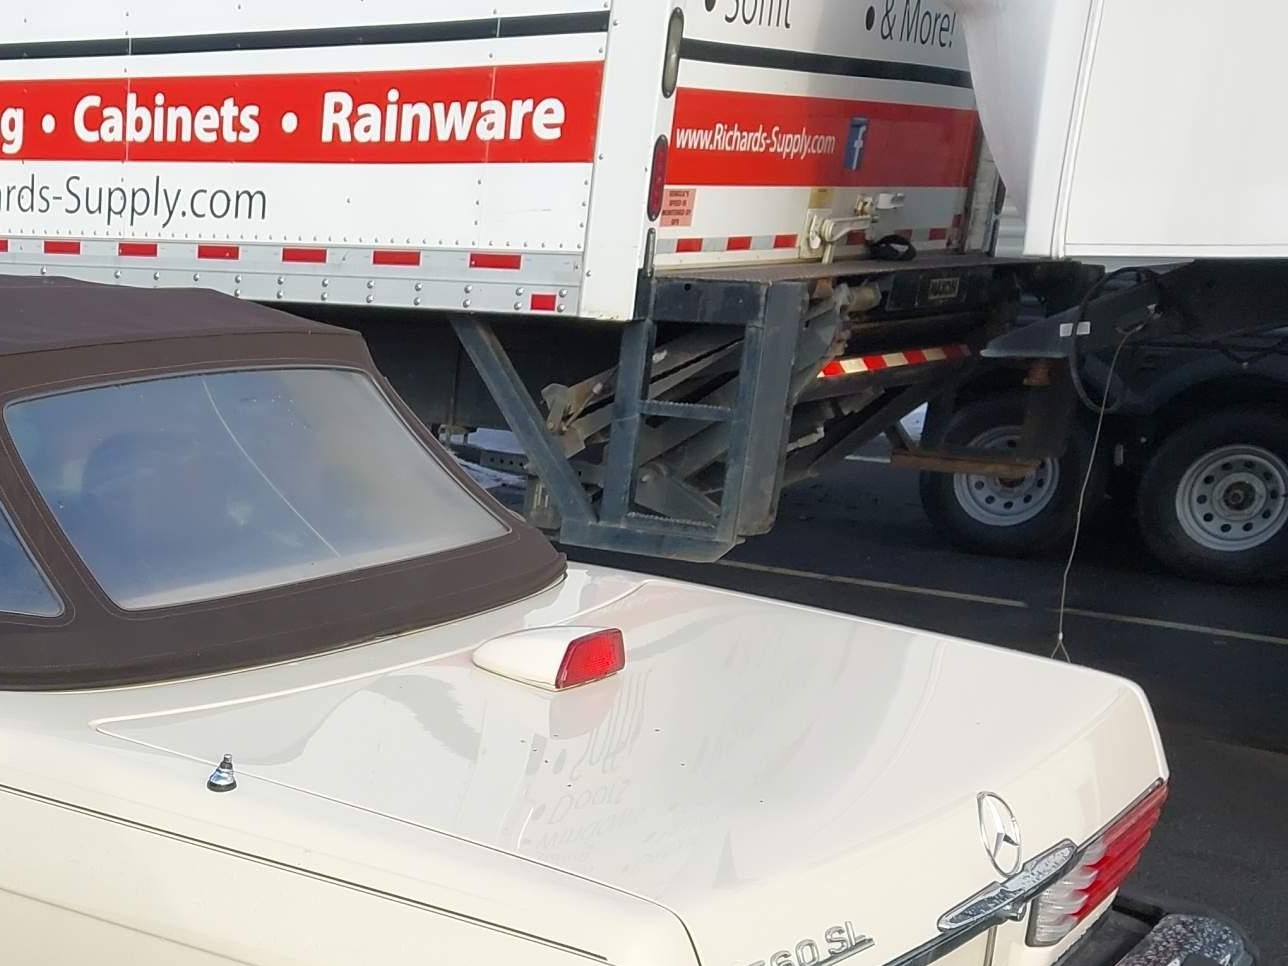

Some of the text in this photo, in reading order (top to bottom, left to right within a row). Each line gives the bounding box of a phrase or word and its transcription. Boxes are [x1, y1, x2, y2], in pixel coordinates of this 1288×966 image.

[880, 0, 957, 48] & More!
[72, 92, 261, 143] Cabinets
[320, 88, 566, 143] Rainware
[676, 122, 836, 160] www.Richards-Supply.com
[824, 920, 866, 956] SL
